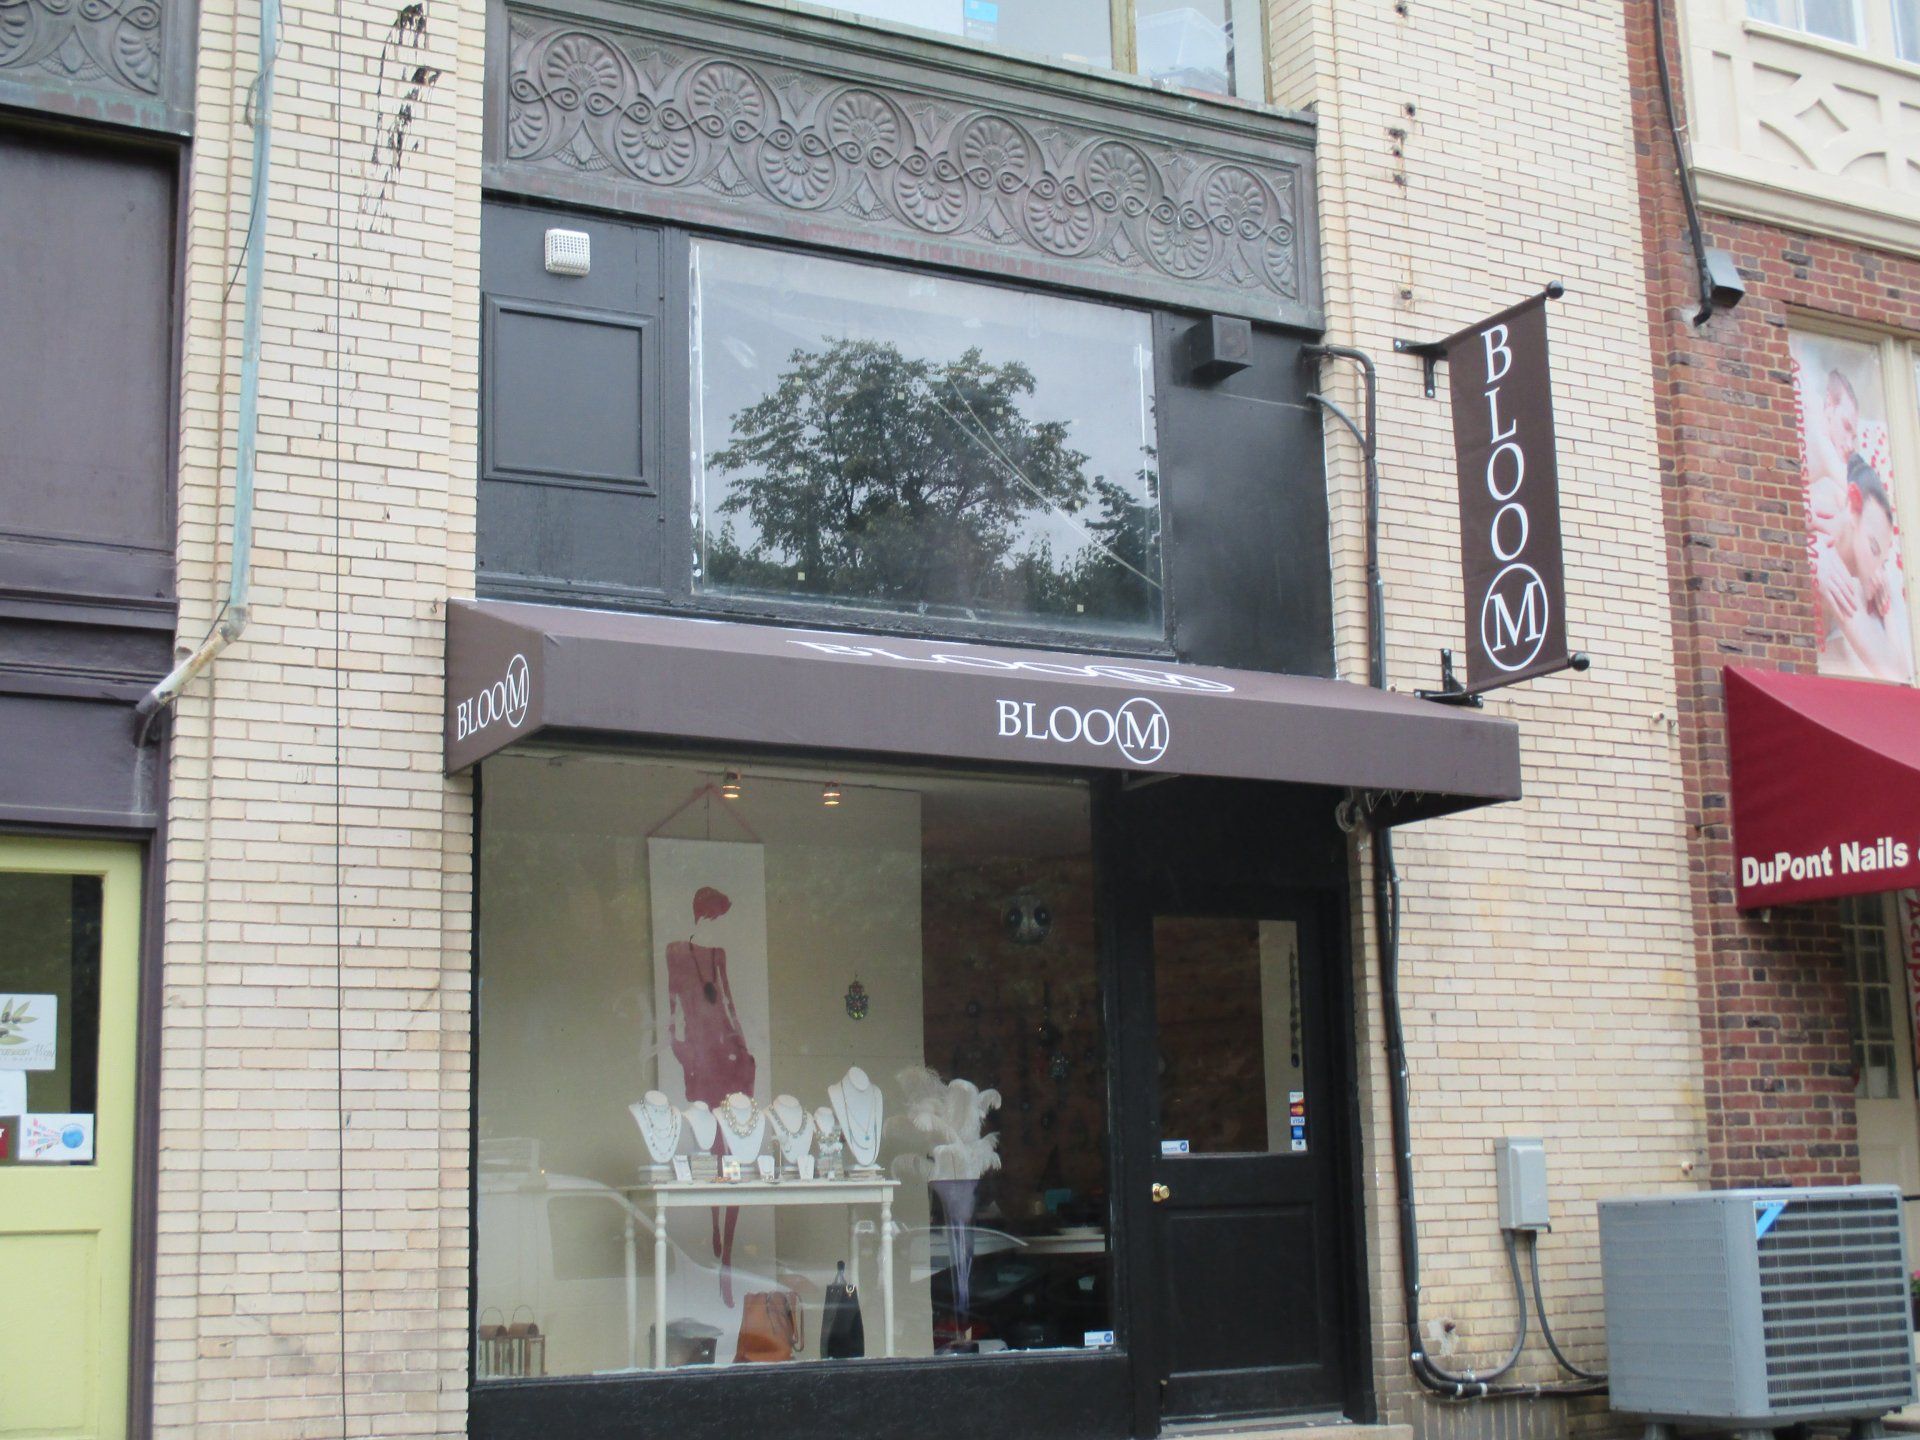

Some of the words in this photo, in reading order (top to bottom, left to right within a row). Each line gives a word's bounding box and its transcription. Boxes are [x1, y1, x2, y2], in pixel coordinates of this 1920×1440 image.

[1481, 323, 1549, 672] BLOOM
[456, 653, 530, 741] BLOOM
[786, 639, 1235, 692] BLOOM
[996, 697, 1170, 764] BLOOM
[1741, 846, 1834, 887] DuPont
[1839, 836, 1909, 875] Nails
